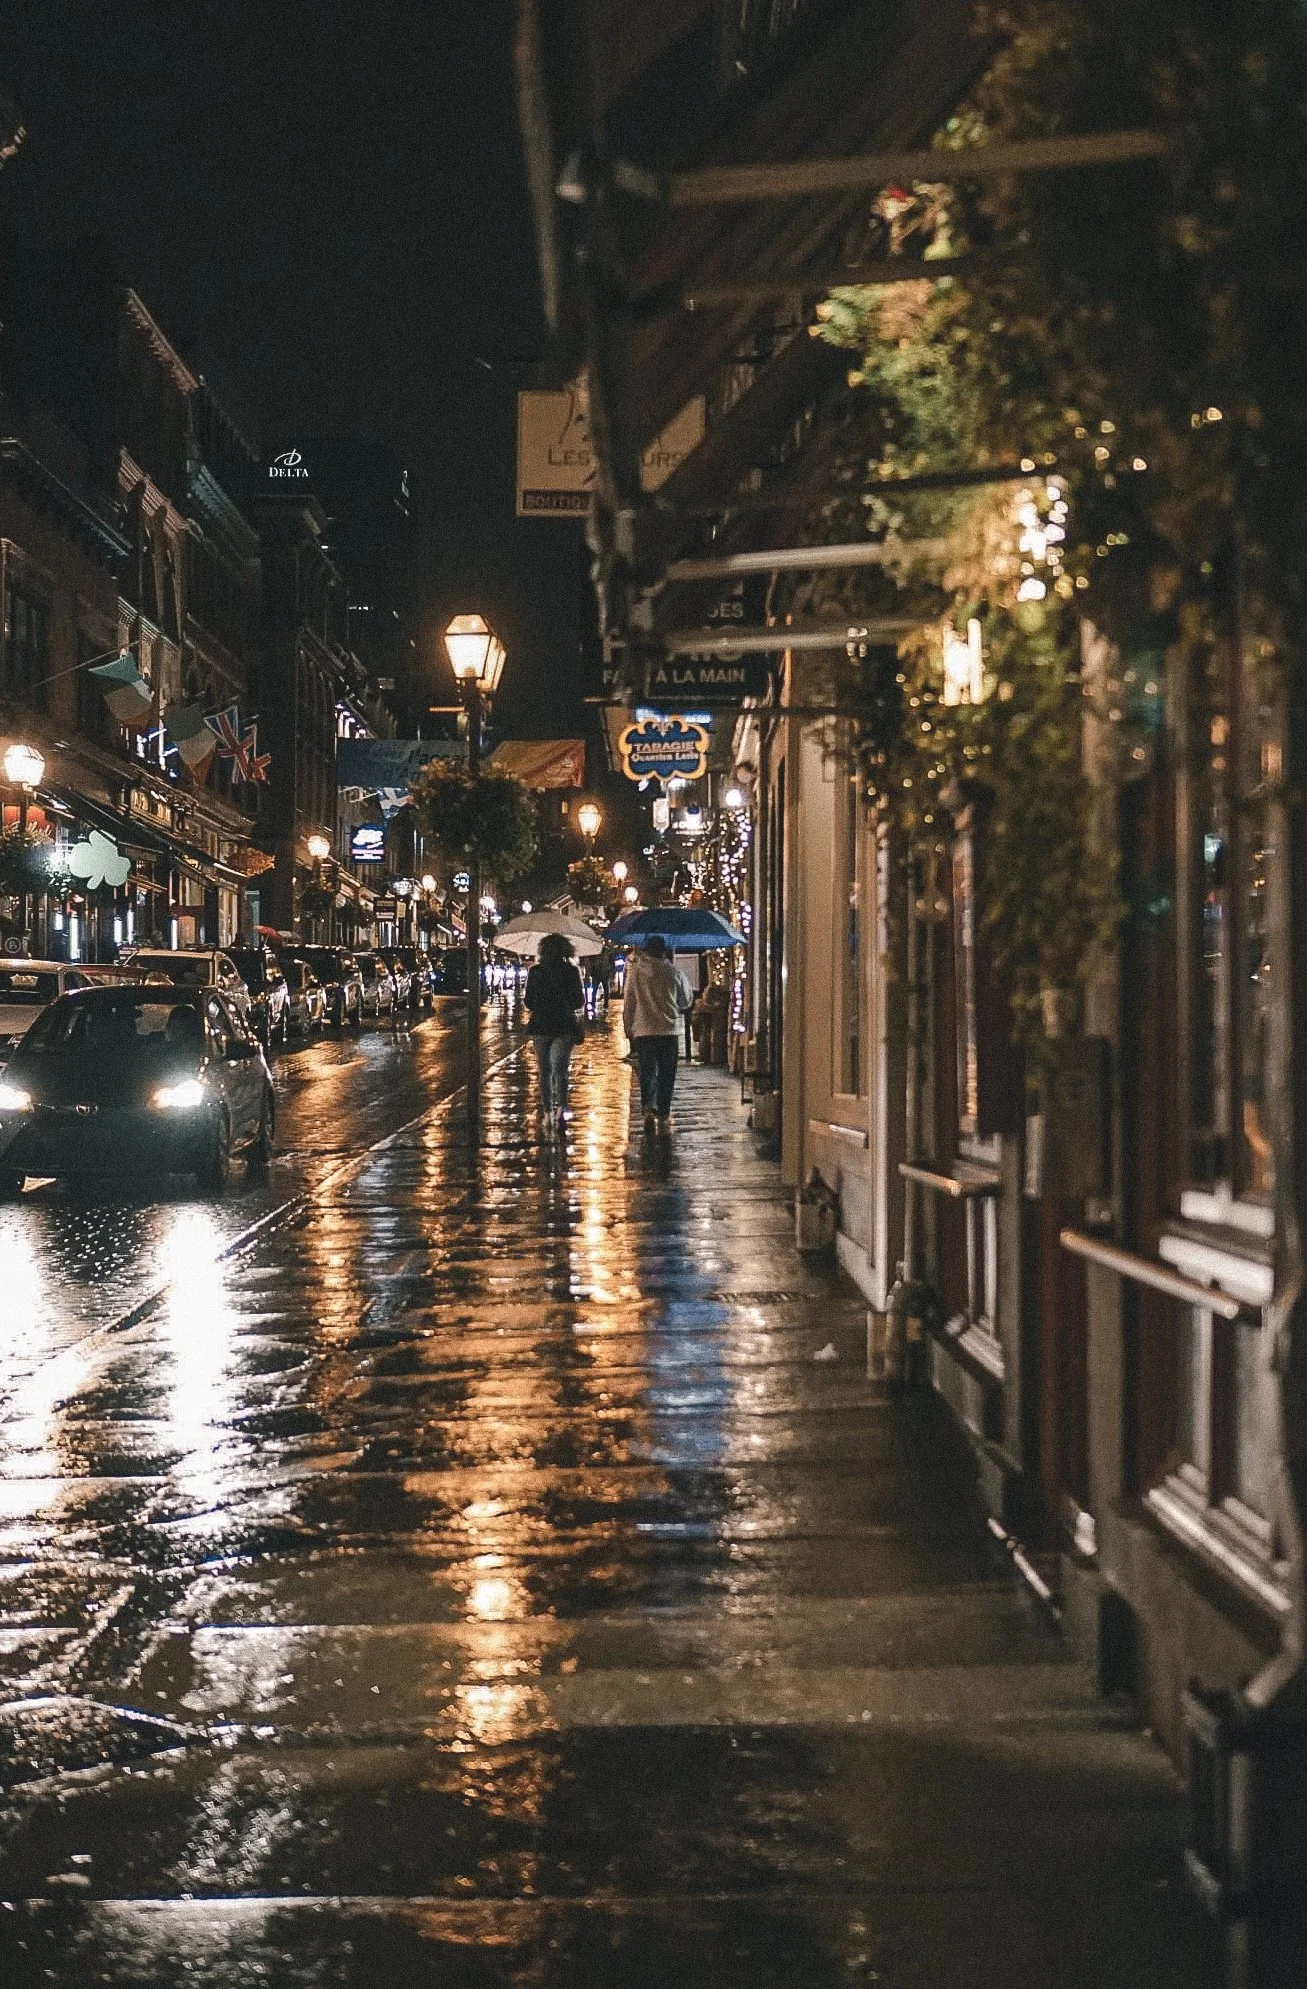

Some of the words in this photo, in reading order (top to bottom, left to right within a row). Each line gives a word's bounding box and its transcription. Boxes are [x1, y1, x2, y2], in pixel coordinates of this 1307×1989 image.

[548, 447, 590, 467] LES
[269, 467, 309, 478] DELTA
[672, 669, 695, 684] LA
[700, 668, 745, 684] MAIN
[632, 741, 695, 753] TABAGIE
